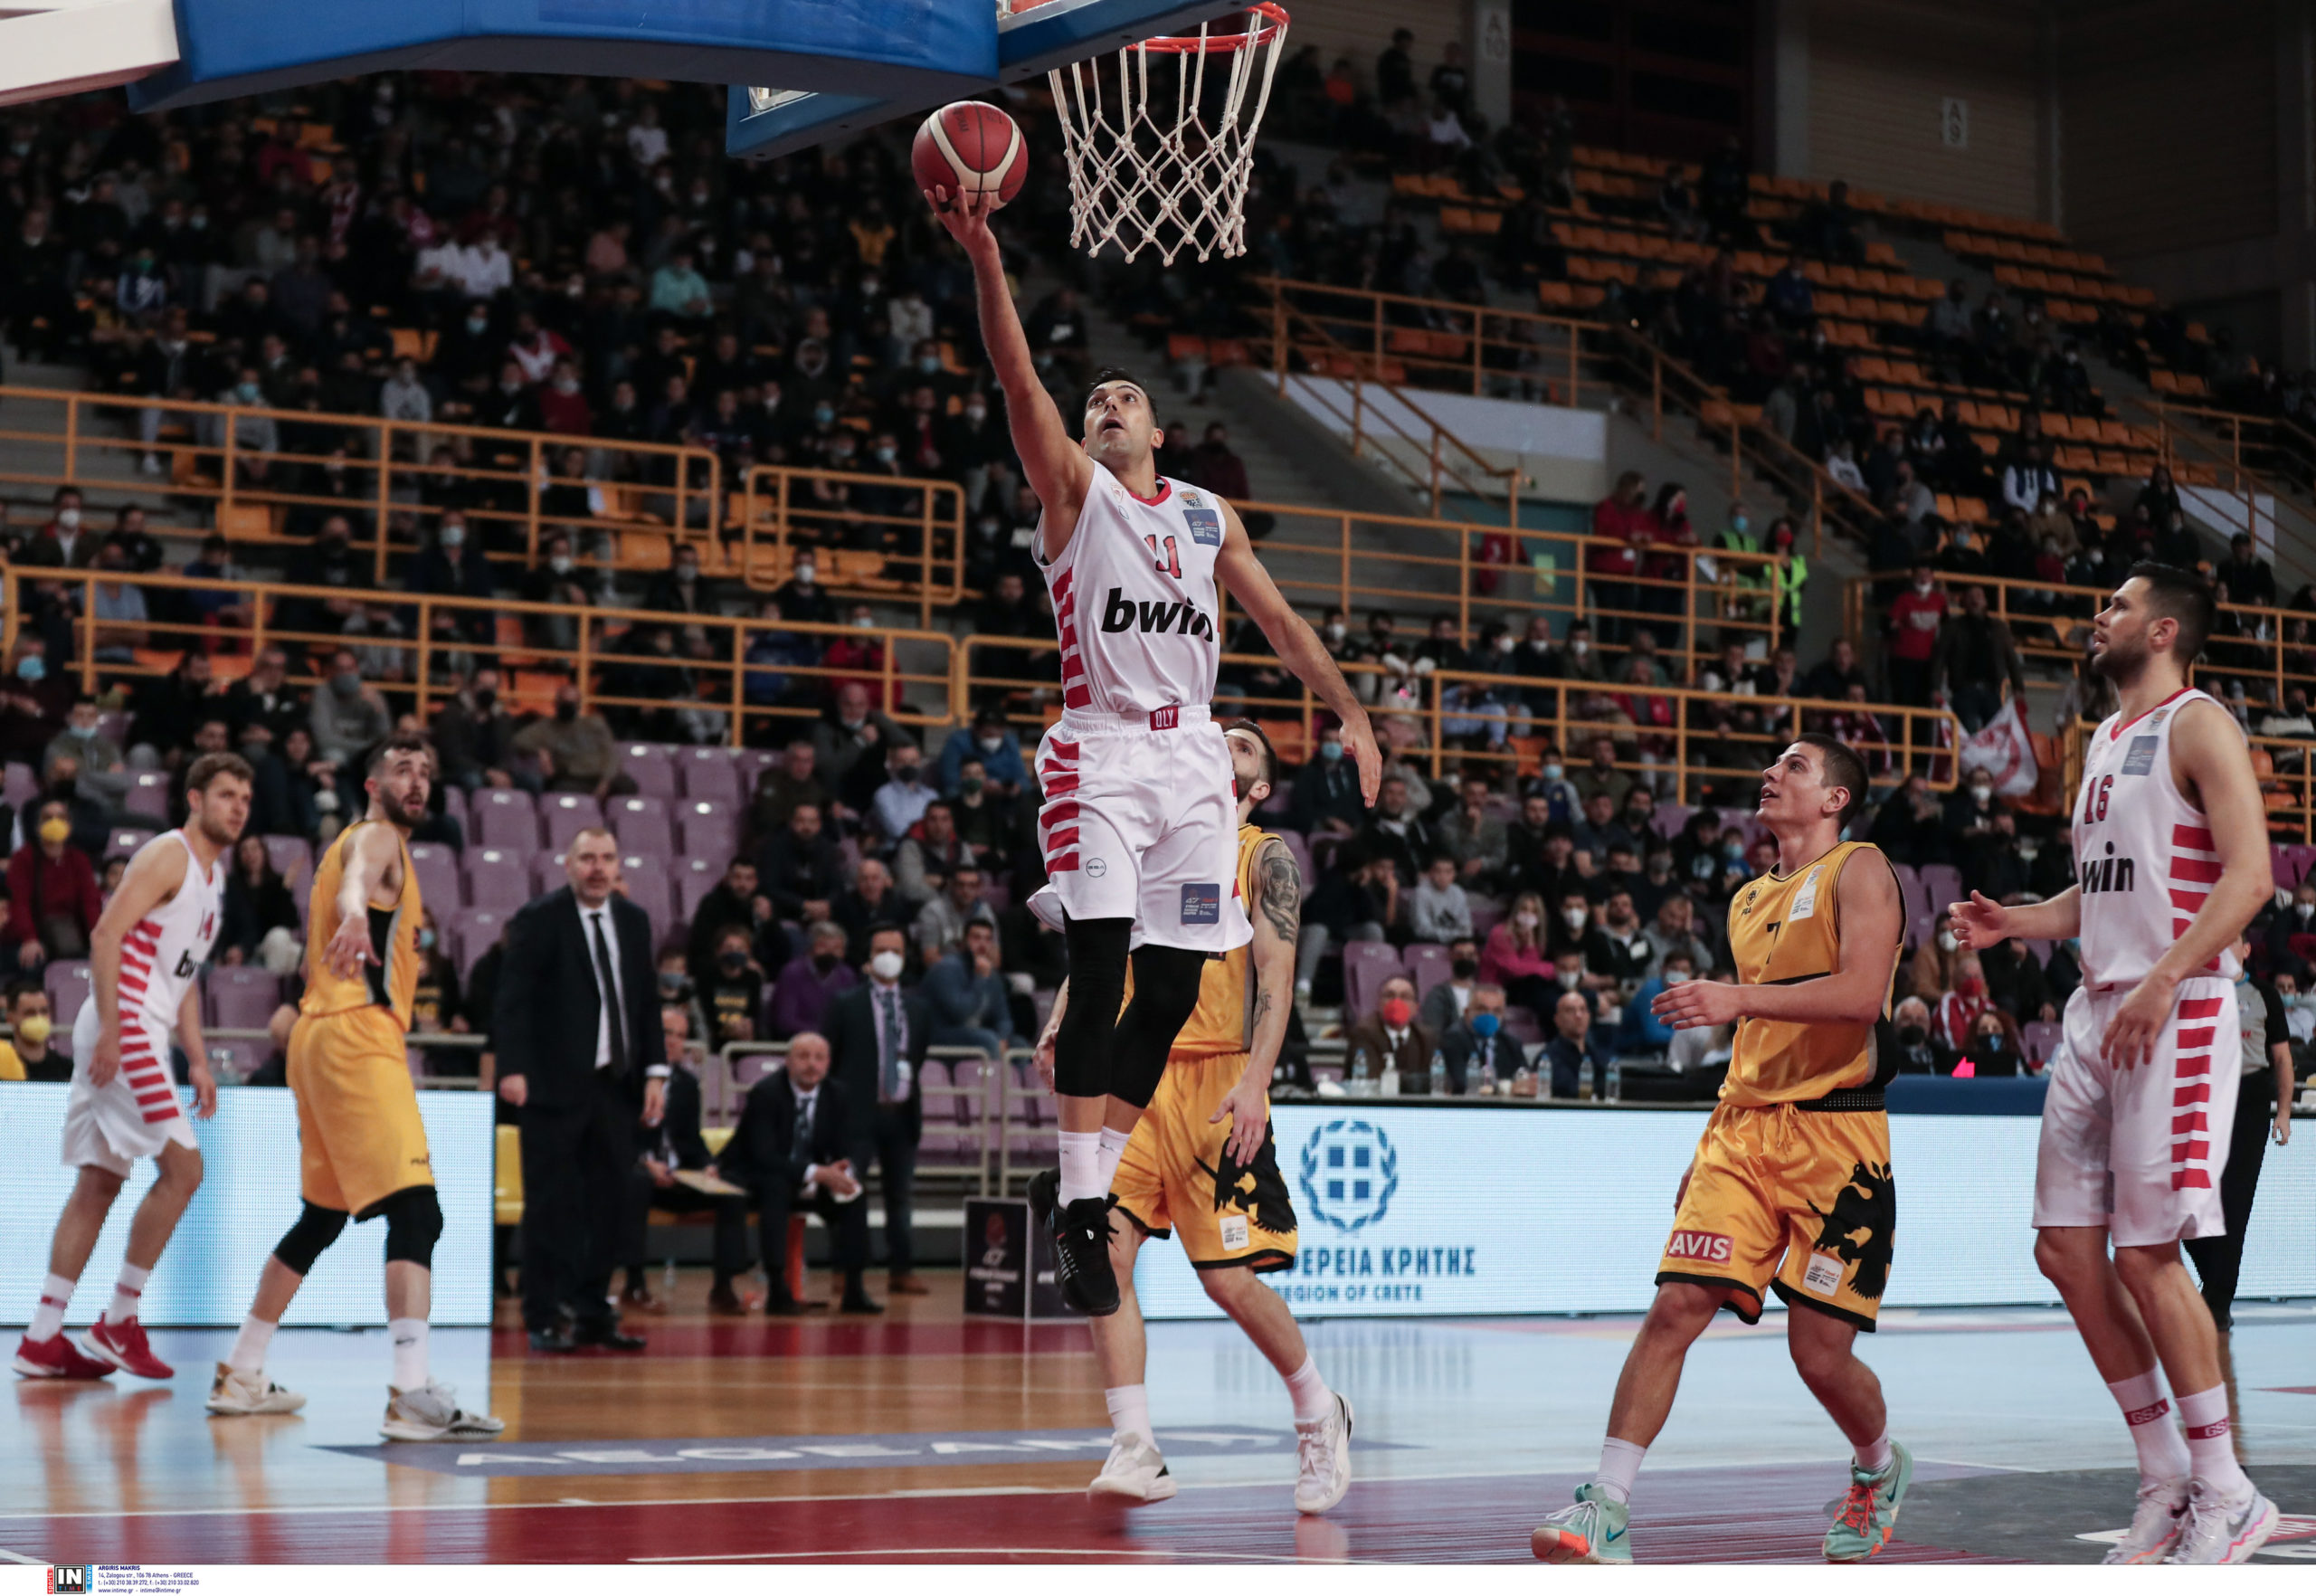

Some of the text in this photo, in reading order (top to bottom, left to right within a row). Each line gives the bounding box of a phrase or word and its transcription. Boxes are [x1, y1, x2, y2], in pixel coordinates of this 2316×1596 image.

[1948, 101, 1961, 122] A
[1949, 124, 1961, 144] 9
[1101, 587, 1213, 642] bwin
[1155, 709, 1173, 727] OLY
[2084, 774, 2114, 824] 16
[1766, 921, 1780, 964] 7
[1669, 1233, 1730, 1260] AVIS
[1288, 1248, 1476, 1276] ΕΡΕΙΑ ΚΡΗΤΗΣ
[2131, 1404, 2166, 1424] GSA
[2205, 1419, 2229, 1437] GS
